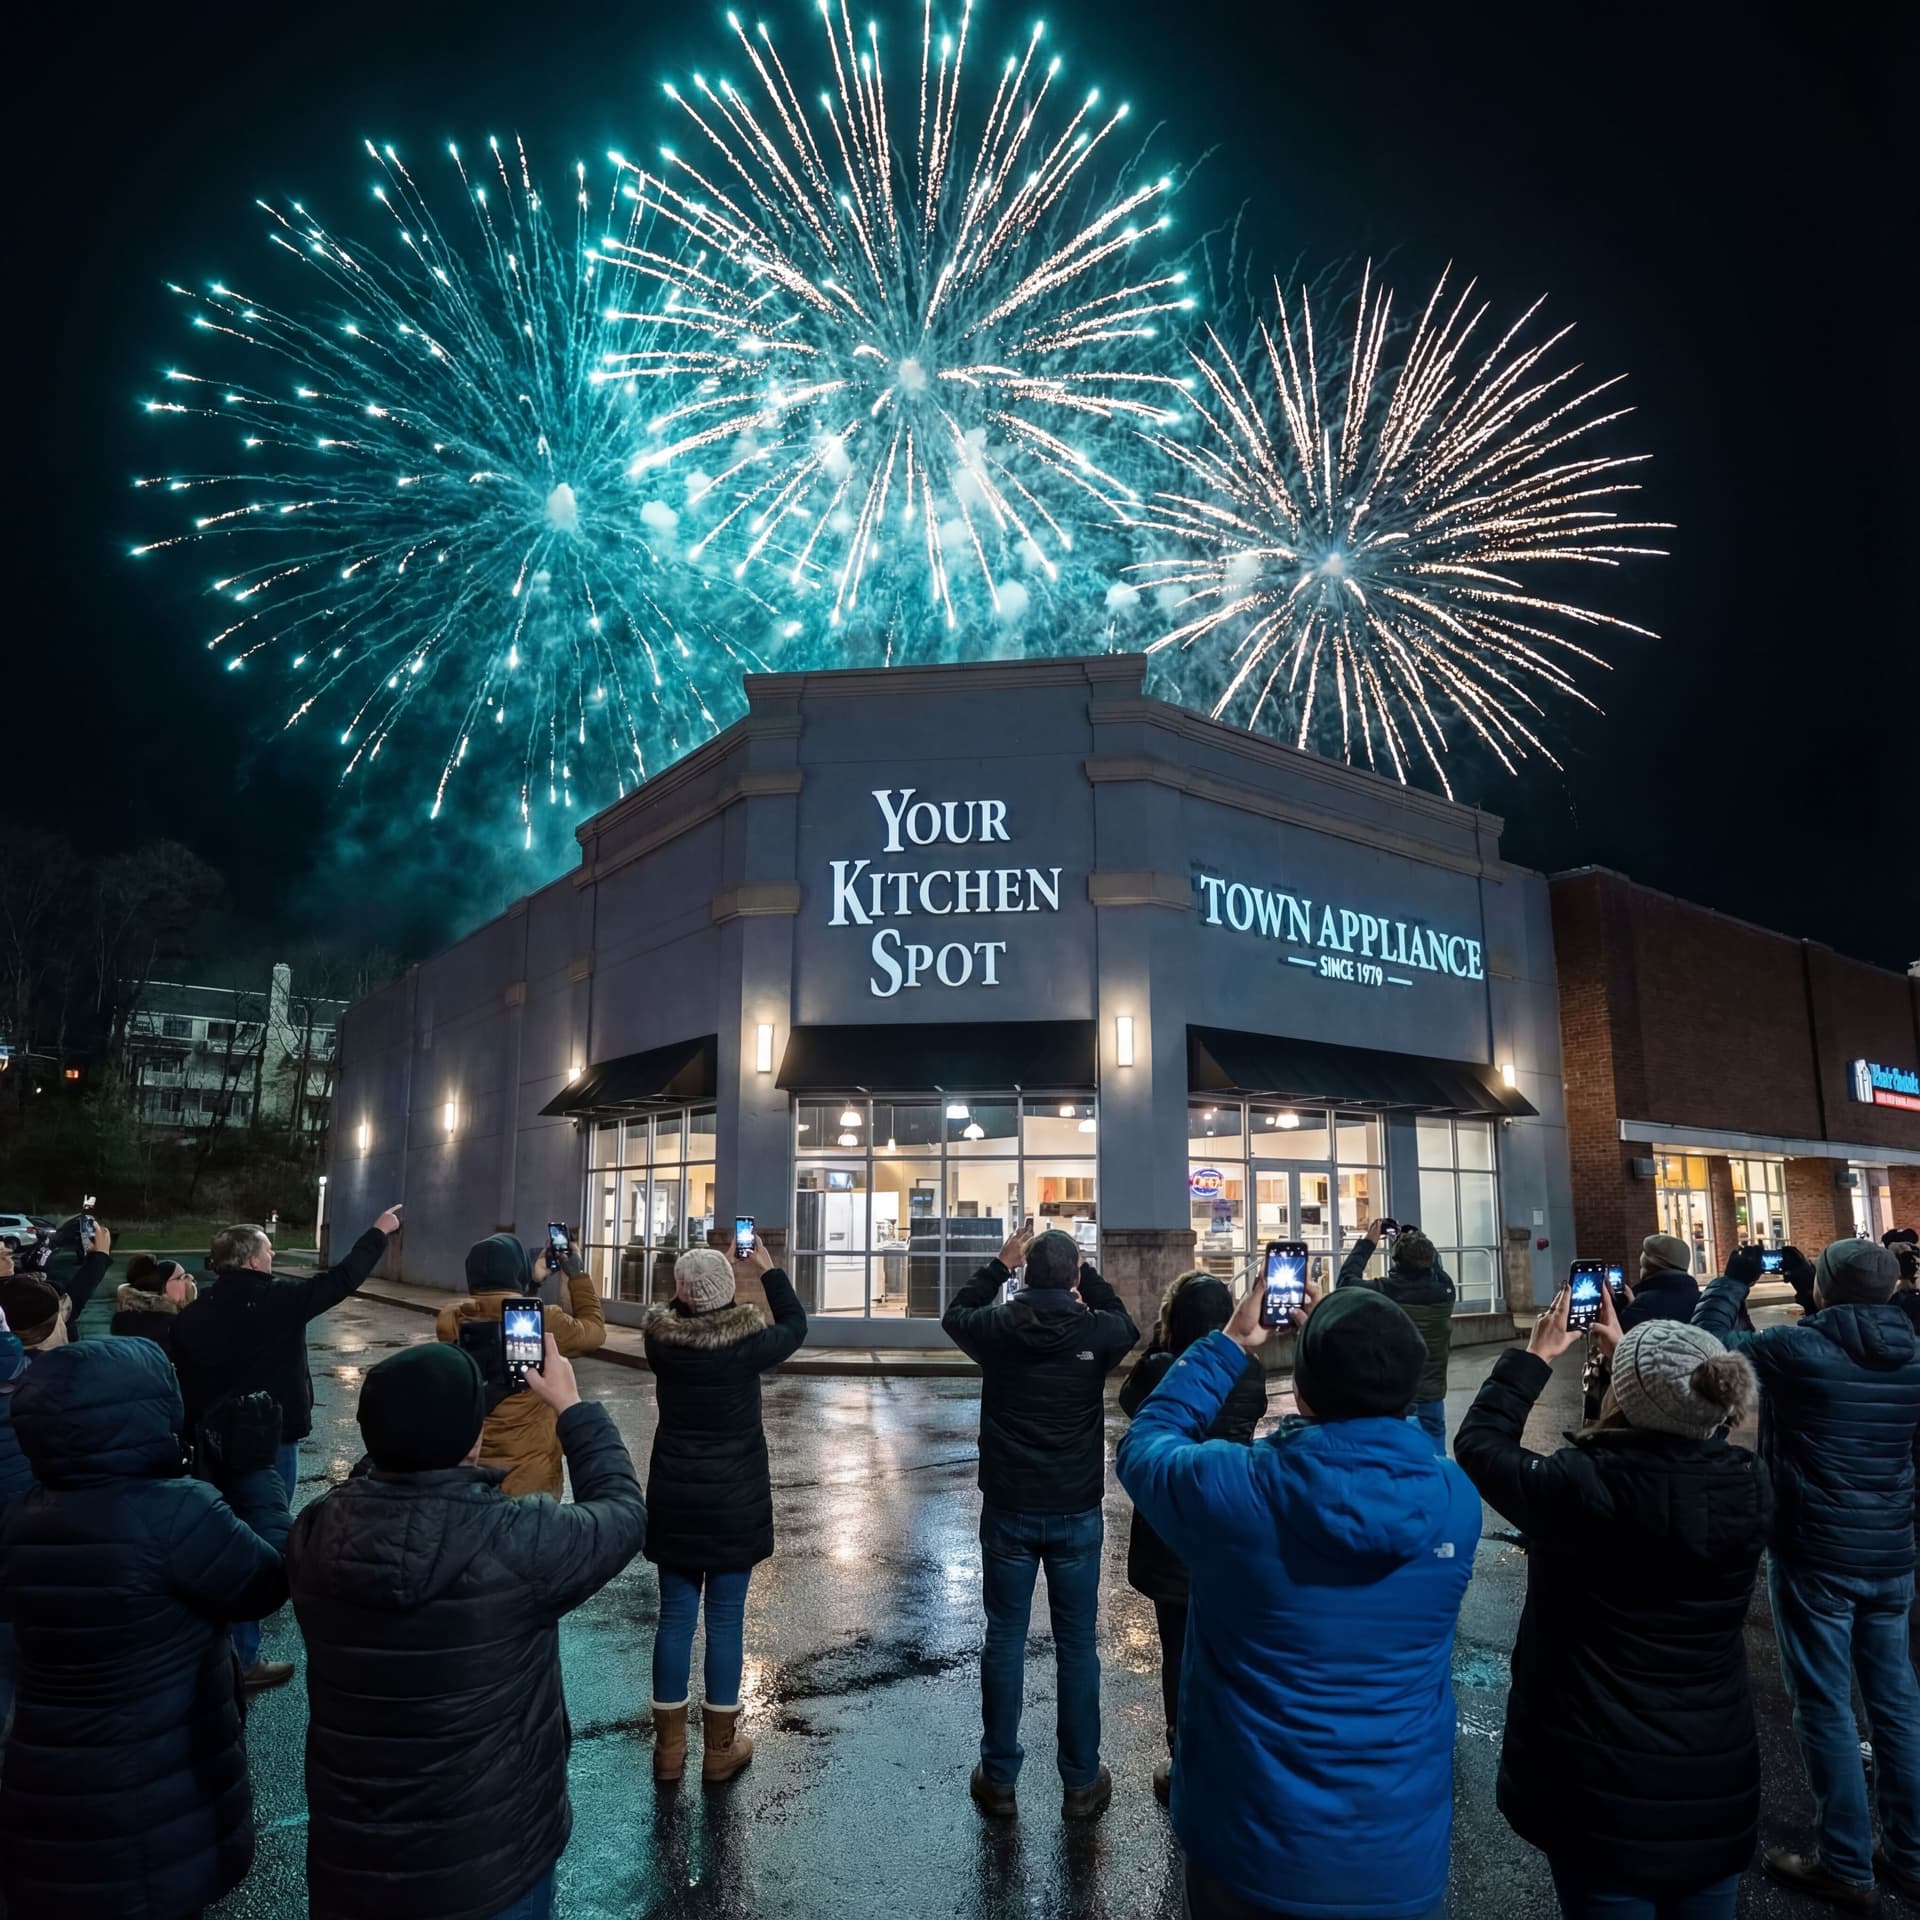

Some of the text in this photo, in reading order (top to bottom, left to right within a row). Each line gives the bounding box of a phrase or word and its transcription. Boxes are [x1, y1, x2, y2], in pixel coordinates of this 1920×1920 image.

[1200, 874, 1484, 980] TOWN APPLIANCE
[1320, 955, 1383, 987] SINCE 1979
